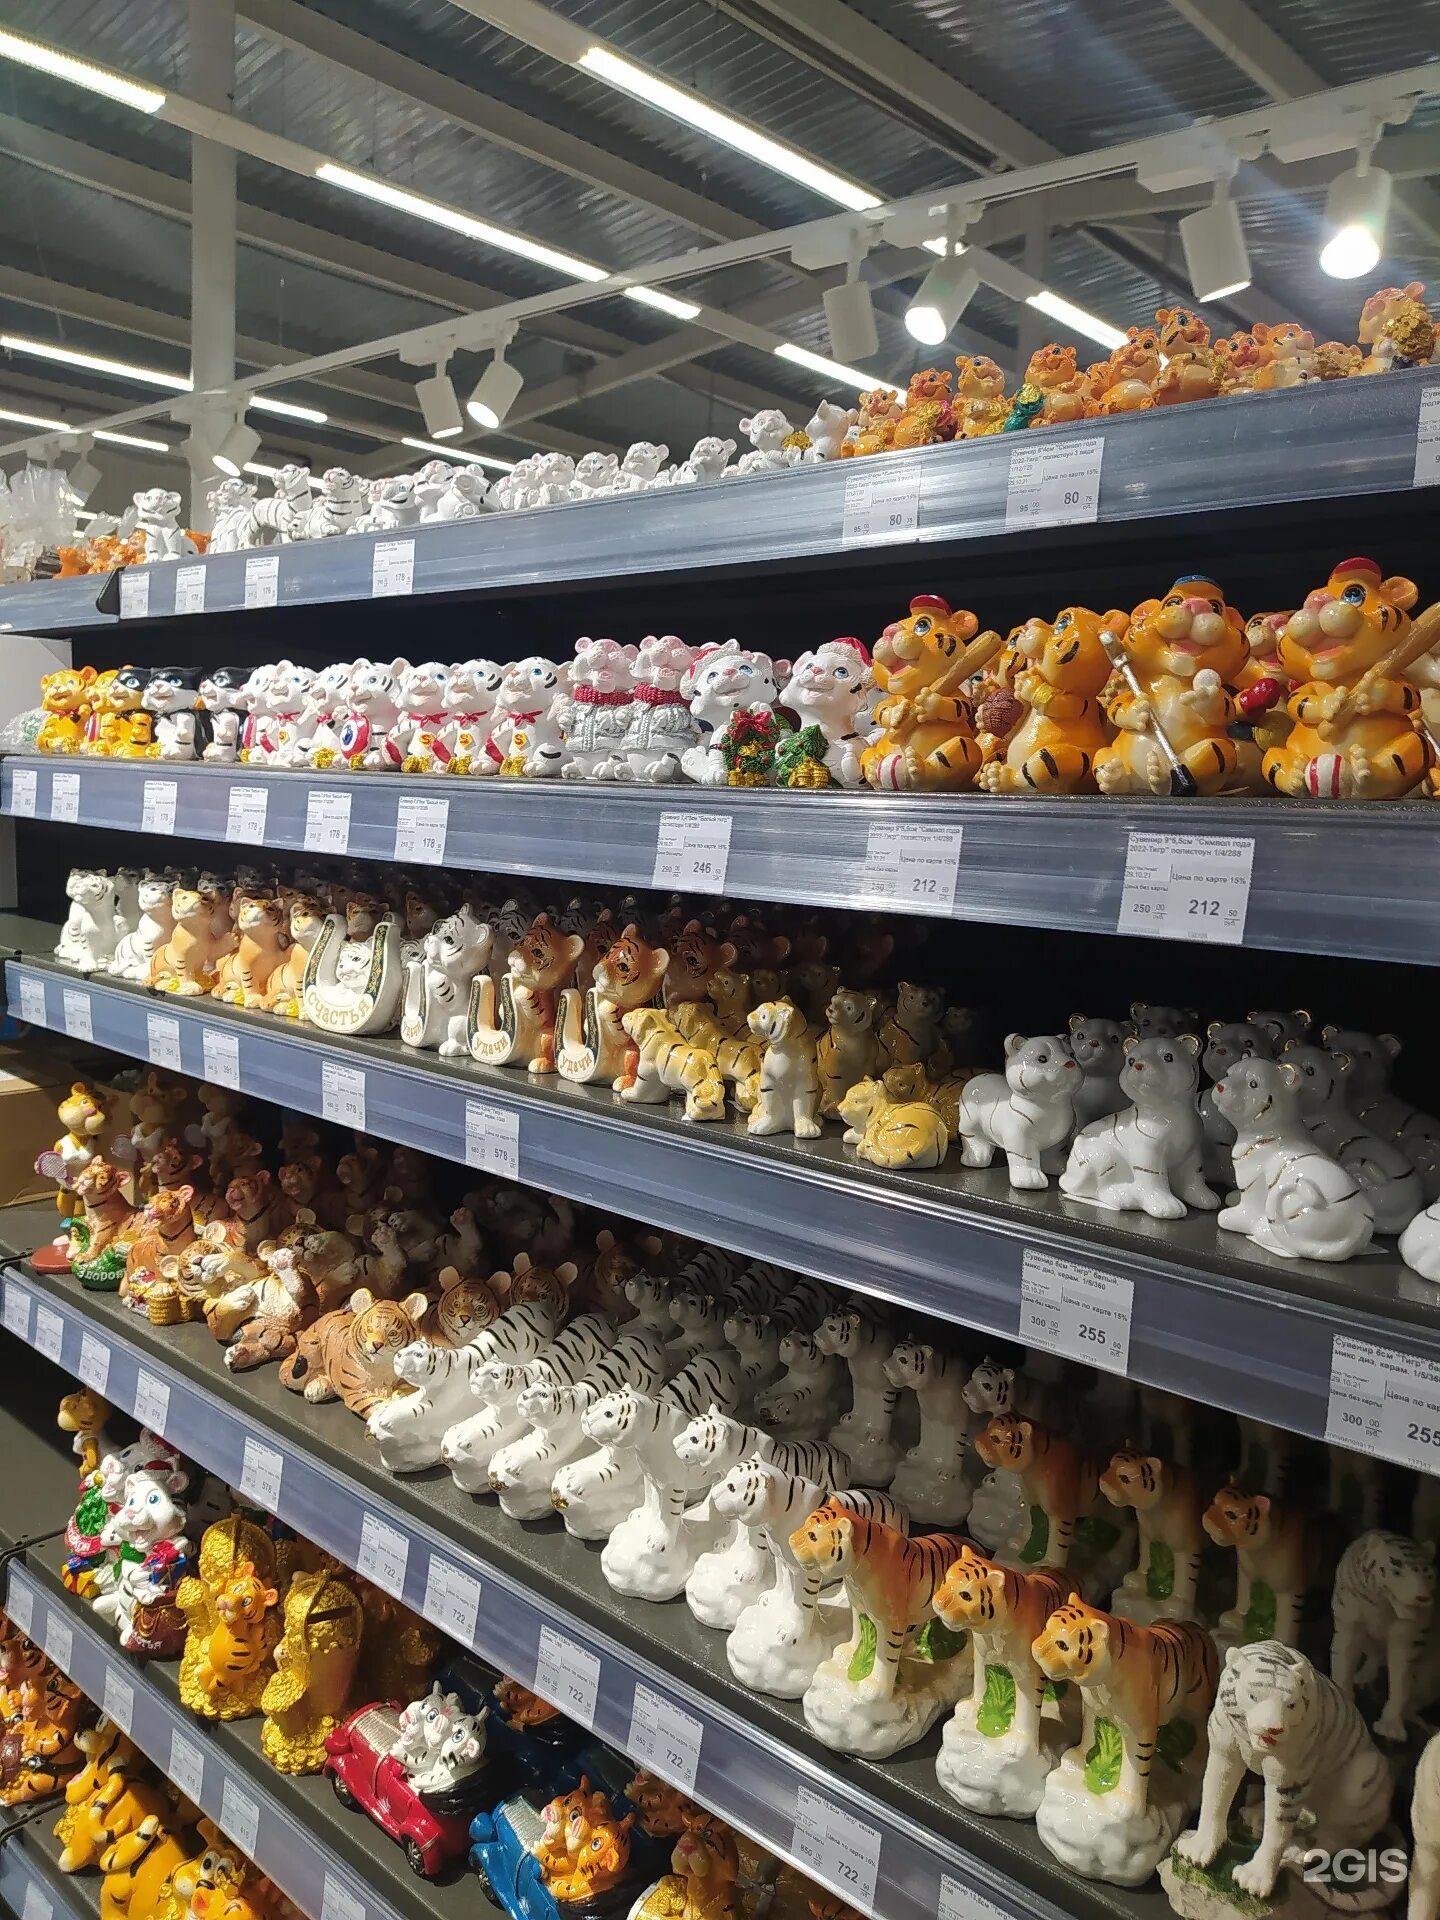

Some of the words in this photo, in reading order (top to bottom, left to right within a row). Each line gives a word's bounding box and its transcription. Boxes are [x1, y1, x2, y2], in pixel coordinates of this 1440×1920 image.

[1020, 504, 1028, 512] 95
[1064, 491, 1079, 504] 80
[890, 514, 902, 525] 80
[422, 734, 431, 744] S
[460, 734, 468, 744] S
[514, 734, 524, 745] S
[330, 830, 340, 838] 178
[1130, 836, 1162, 844] Сувенир
[1195, 838, 1230, 847] "Символ
[423, 838, 435, 848] 178
[1130, 845, 1169, 854] 2022-Тигр"
[1171, 848, 1211, 856] полистоун
[693, 862, 711, 873] 246
[1172, 873, 1191, 881] Цена
[912, 879, 937, 892] 212
[1133, 904, 1151, 913] 250
[1188, 899, 1220, 916] 212
[346, 1103, 356, 1113] 578
[495, 1148, 507, 1160] 578
[1025, 1252, 1054, 1266] Сувенир
[1070, 1264, 1092, 1276] "Тигр"
[1094, 1271, 1119, 1286] белый,
[1063, 1296, 1080, 1306] Цена
[1092, 1306, 1111, 1317] карте
[1114, 1312, 1128, 1322] 15%
[1031, 1316, 1046, 1327] 300
[1050, 1320, 1058, 1328] 00
[1078, 1324, 1106, 1344] 255
[1335, 1338, 1373, 1355] Сувенир
[1396, 1354, 1425, 1367] "Тигр"
[1334, 1349, 1356, 1360] микс
[1379, 1362, 1410, 1375] керам.
[1331, 1376, 1360, 1389] 29.10.21
[1330, 1388, 1347, 1398] Цена
[1348, 1393, 1360, 1401] без
[1362, 1398, 1382, 1408] карты
[1387, 1390, 1410, 1403] Цена
[1412, 1398, 1424, 1407] по
[1426, 1403, 1440, 1413] кар
[1342, 1412, 1362, 1426] 300
[1369, 1419, 1379, 1427] 00
[1407, 1423, 1440, 1447] 255
[384, 1563, 395, 1579] 722
[453, 1608, 465, 1624] 722
[568, 1685, 584, 1703] 722
[666, 1749, 683, 1769] 722
[800, 1844, 812, 1856] 850
[838, 1861, 858, 1884] 722
